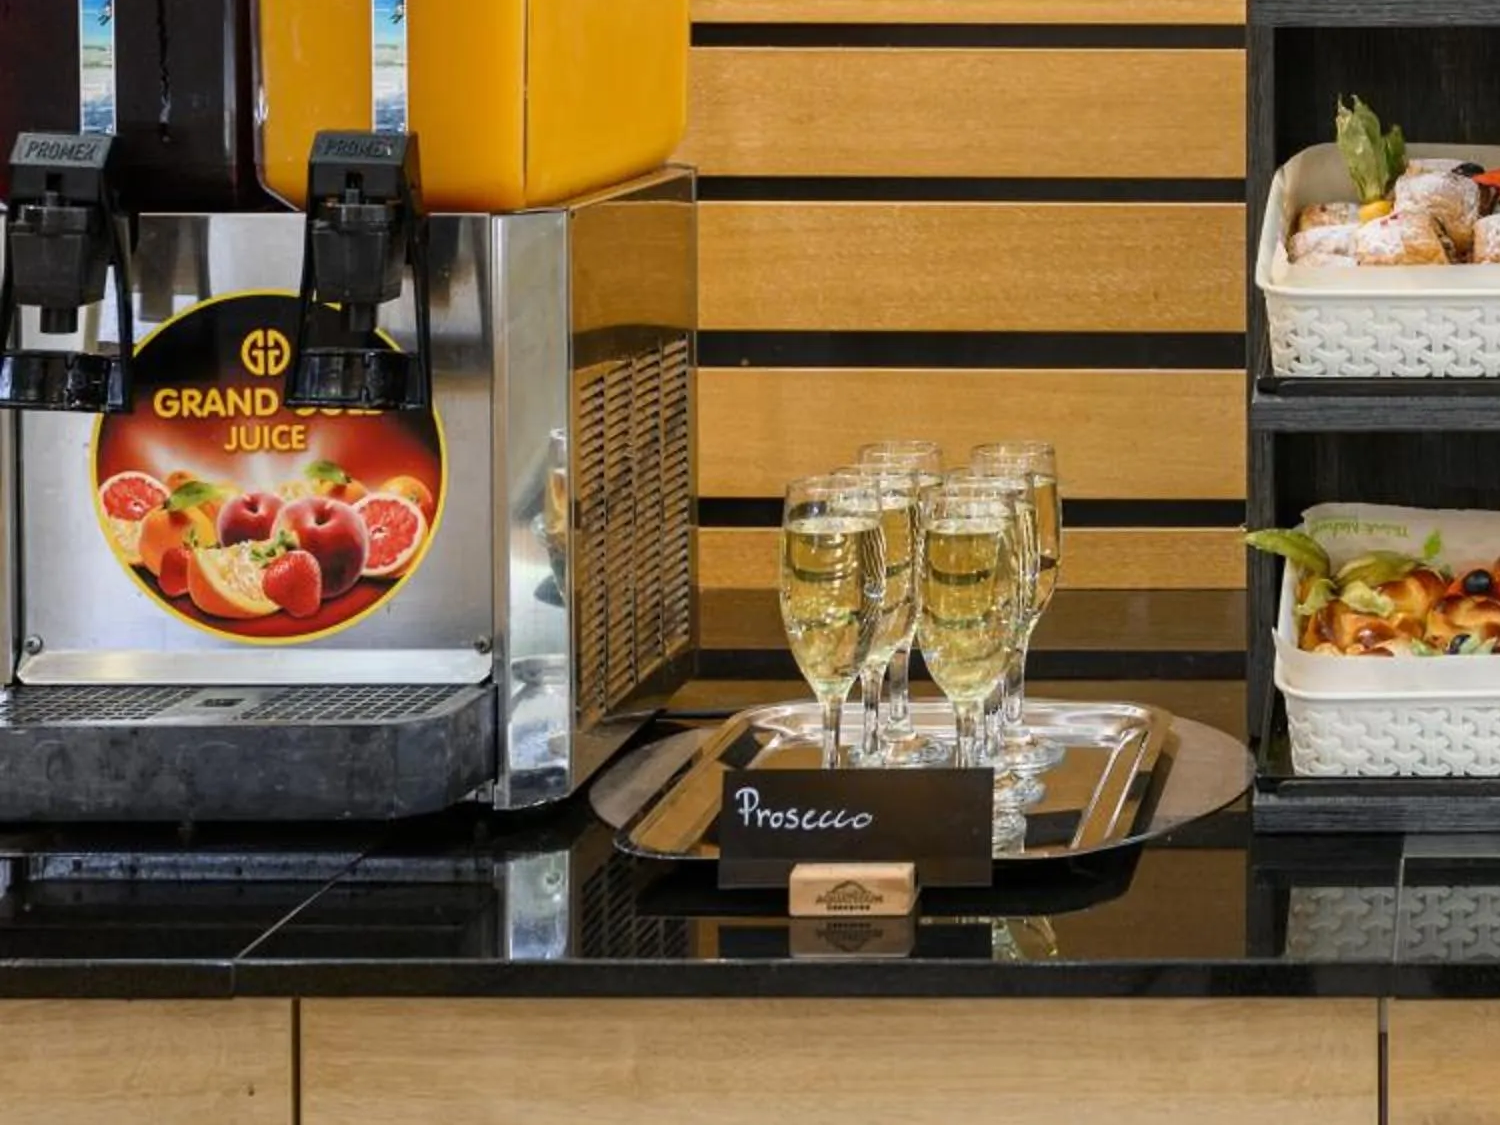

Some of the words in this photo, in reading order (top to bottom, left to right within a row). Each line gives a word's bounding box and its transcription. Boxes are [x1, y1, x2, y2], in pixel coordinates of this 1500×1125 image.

[24, 140, 98, 161] PROMEX
[153, 387, 279, 418] GRAND
[224, 425, 306, 451] JUICE
[734, 786, 873, 829] Prosecco
